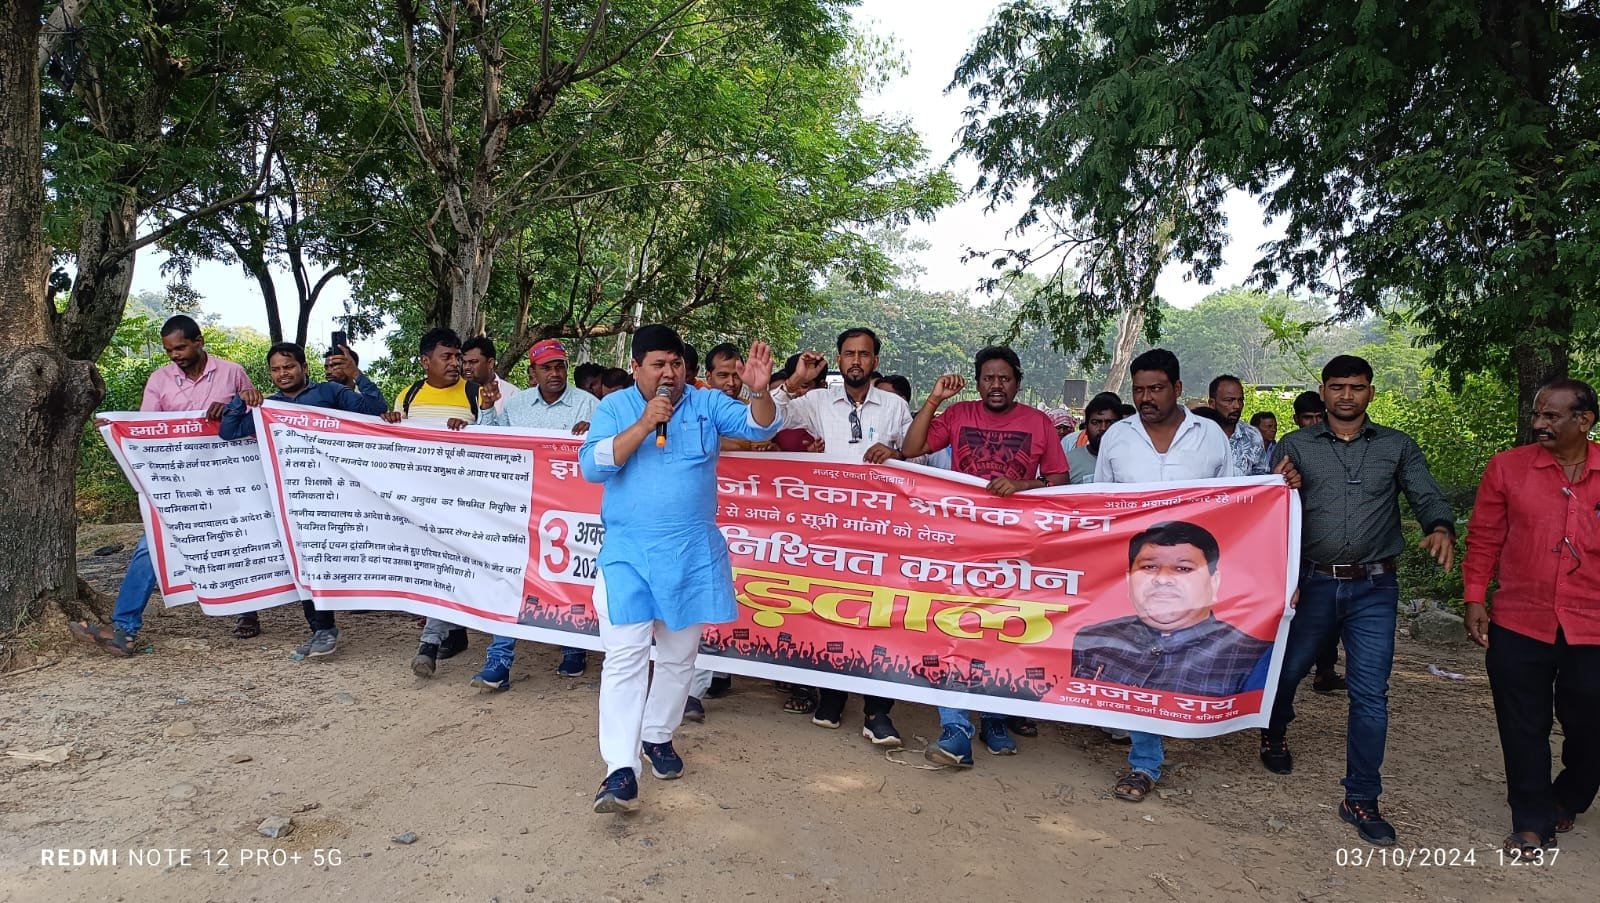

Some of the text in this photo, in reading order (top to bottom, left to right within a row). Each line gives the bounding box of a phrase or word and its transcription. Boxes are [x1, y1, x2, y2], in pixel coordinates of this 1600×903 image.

[128, 422, 170, 436] हमारी
[318, 437, 345, 447] व्यवस्था
[365, 441, 377, 450] कर
[378, 442, 394, 452] ऊर्जा
[418, 448, 435, 456] 2017
[436, 446, 443, 456] से
[444, 448, 455, 460] पूर्व
[456, 448, 466, 458] की
[466, 451, 493, 460] व्यवस्था
[494, 454, 510, 464] लागू
[200, 460, 211, 468] पर
[242, 454, 260, 463] 1000
[406, 462, 414, 472] से
[415, 464, 432, 472] ऊपर
[458, 466, 465, 476] के
[812, 468, 840, 480] मजदूर
[152, 492, 171, 500] पारा
[206, 488, 214, 496] के
[217, 486, 232, 496] तर्ज
[235, 486, 246, 494] पर
[251, 484, 262, 492] 60
[337, 478, 345, 486] के
[442, 498, 454, 506] कर
[717, 474, 1118, 532] र्जा विकास श्रमिक संघ
[1104, 500, 1138, 510] अशोक
[1215, 493, 1230, 504] रहे
[194, 510, 272, 528] न्यायालय के आदेश के
[316, 510, 352, 518] न्यायालय
[354, 509, 362, 518] के
[363, 510, 383, 520] आदेश
[384, 512, 391, 521] के
[429, 524, 436, 534] से
[437, 527, 454, 536] ऊपर
[472, 530, 484, 540] देने
[724, 503, 740, 518] से
[744, 506, 781, 522] अपने
[786, 512, 796, 523] 6
[801, 511, 838, 531] सूत्री
[843, 516, 891, 536] मांगों
[893, 522, 913, 539] को
[918, 526, 956, 545] लेकर
[328, 522, 355, 534] नियुक्ति
[329, 541, 348, 550] एवम
[544, 518, 570, 574] 3
[324, 554, 341, 563] दिया
[360, 554, 366, 564] है
[382, 557, 392, 565] पर
[208, 564, 226, 573] दिया
[899, 554, 1084, 596] कालीन
[209, 582, 218, 590] के
[219, 578, 249, 590] अनुसार
[324, 572, 331, 580] के
[332, 574, 362, 583] अनुसार
[364, 574, 386, 582] समान
[732, 566, 1069, 644] ड़ताल
[1066, 681, 1236, 712] अजय राय
[1134, 704, 1157, 716] ऊर्जा
[1159, 707, 1192, 720] विकास
[1196, 712, 1223, 722] श्रमिक
